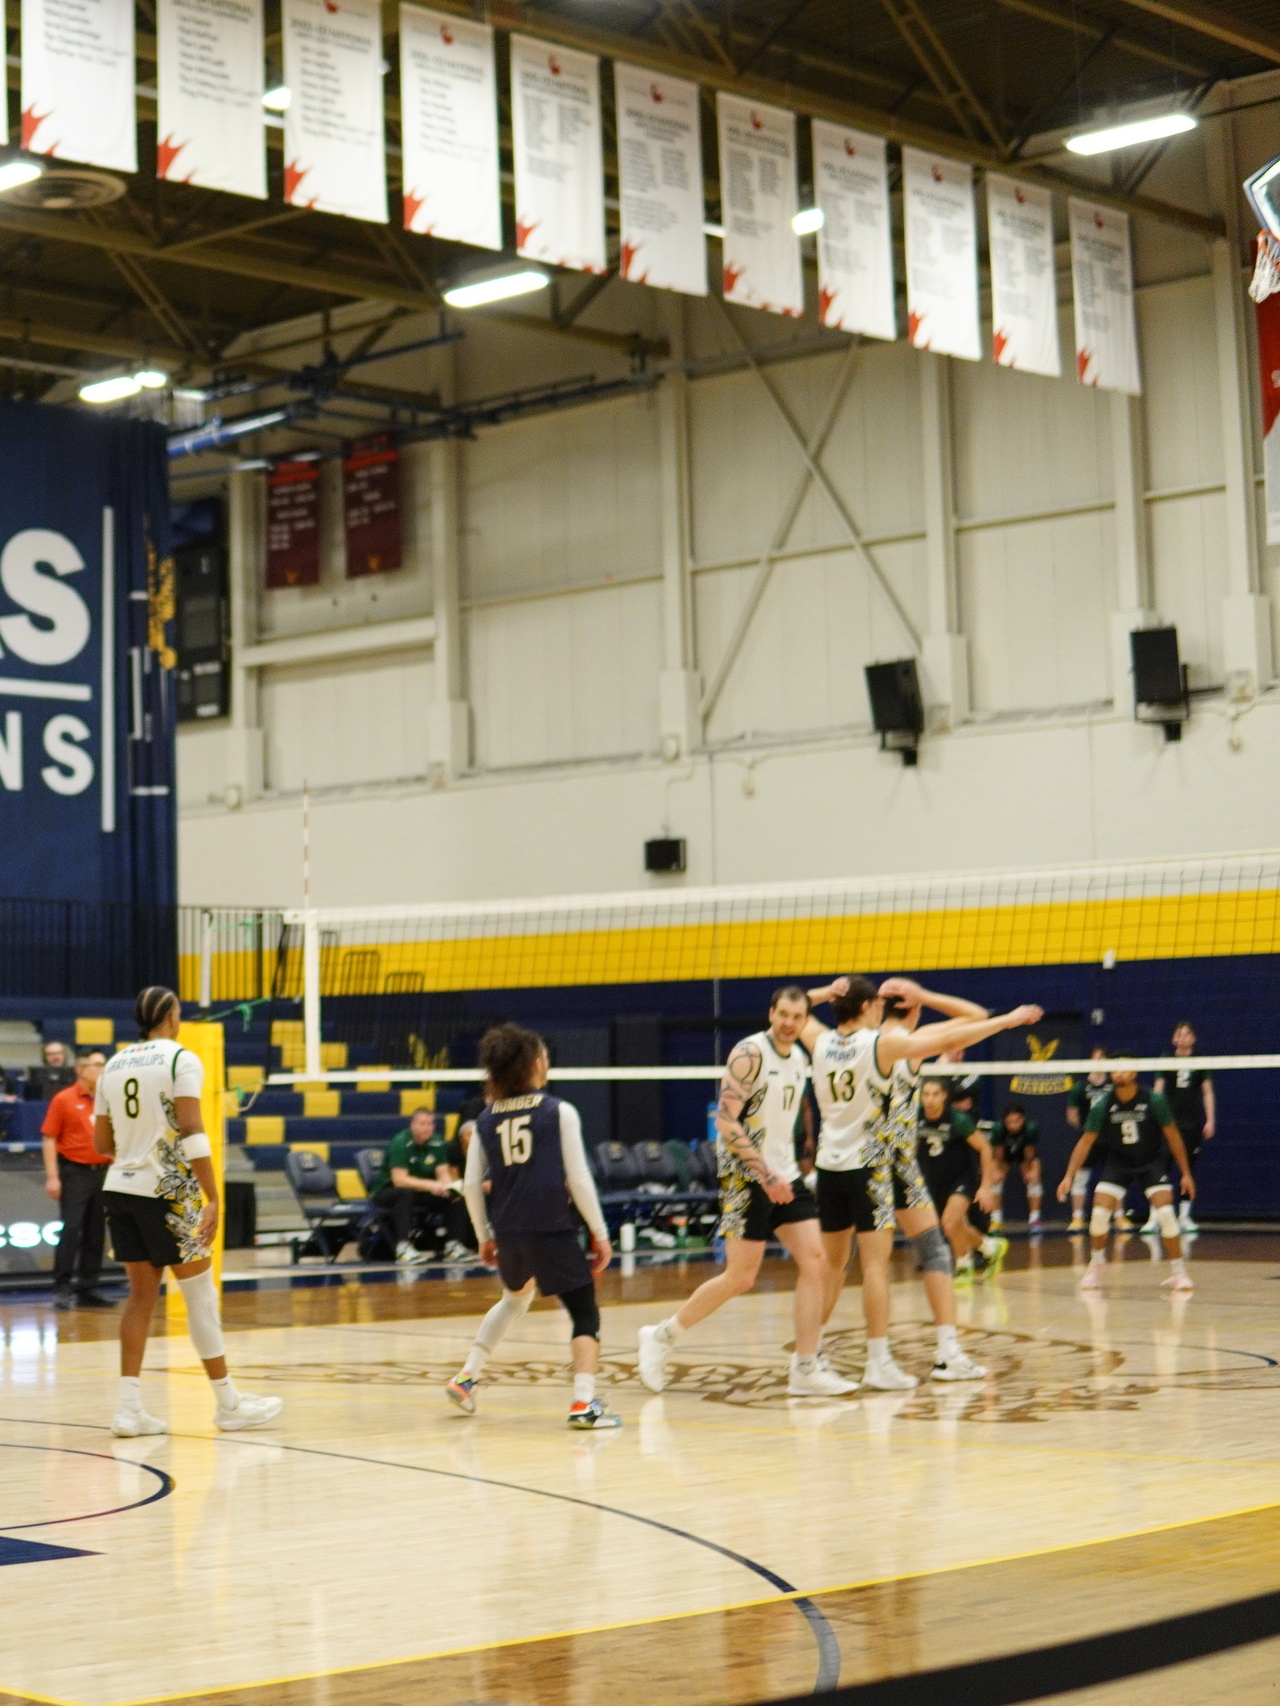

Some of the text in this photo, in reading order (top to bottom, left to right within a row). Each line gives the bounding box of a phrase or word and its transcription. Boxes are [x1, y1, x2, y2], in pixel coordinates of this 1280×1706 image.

[124, 1077, 140, 1119] 8
[783, 1084, 795, 1111] 17
[827, 1069, 855, 1103] 13
[496, 1114, 531, 1167] 15
